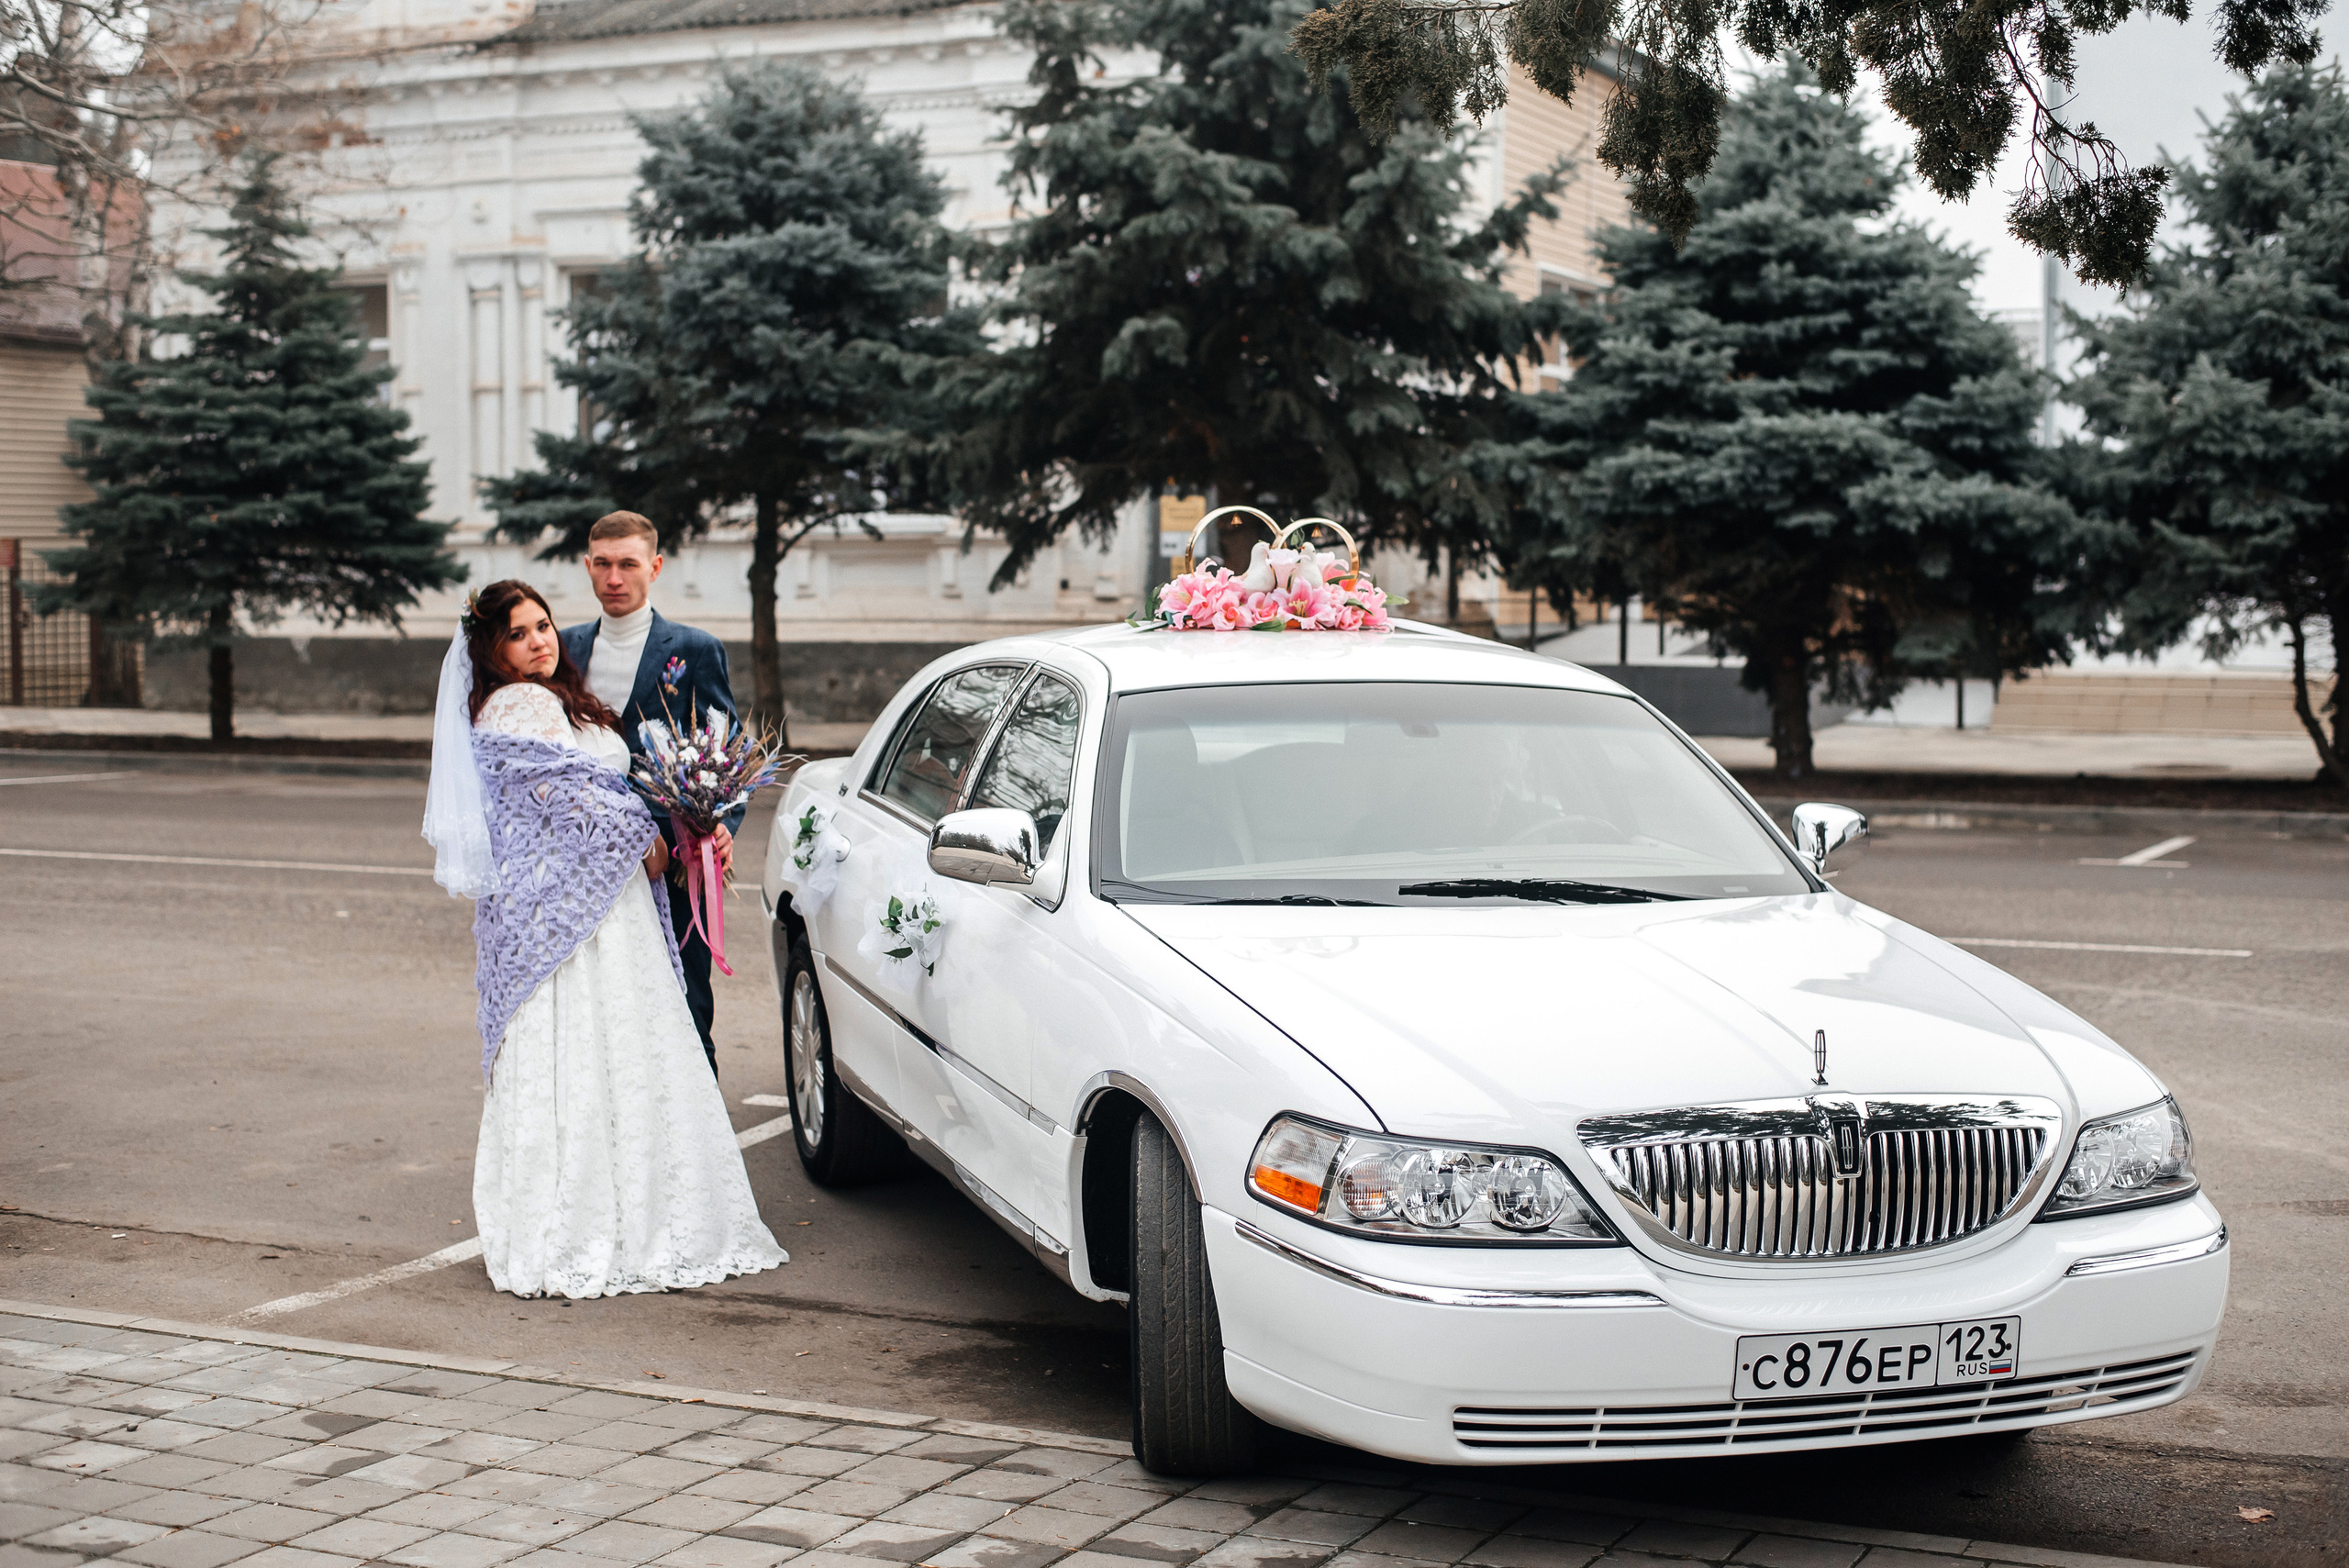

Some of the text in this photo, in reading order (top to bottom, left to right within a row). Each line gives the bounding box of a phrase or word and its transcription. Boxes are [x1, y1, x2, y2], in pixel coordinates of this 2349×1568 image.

[1752, 1323, 2008, 1390] C876EP 123
[1956, 1361, 1987, 1377] RUS
